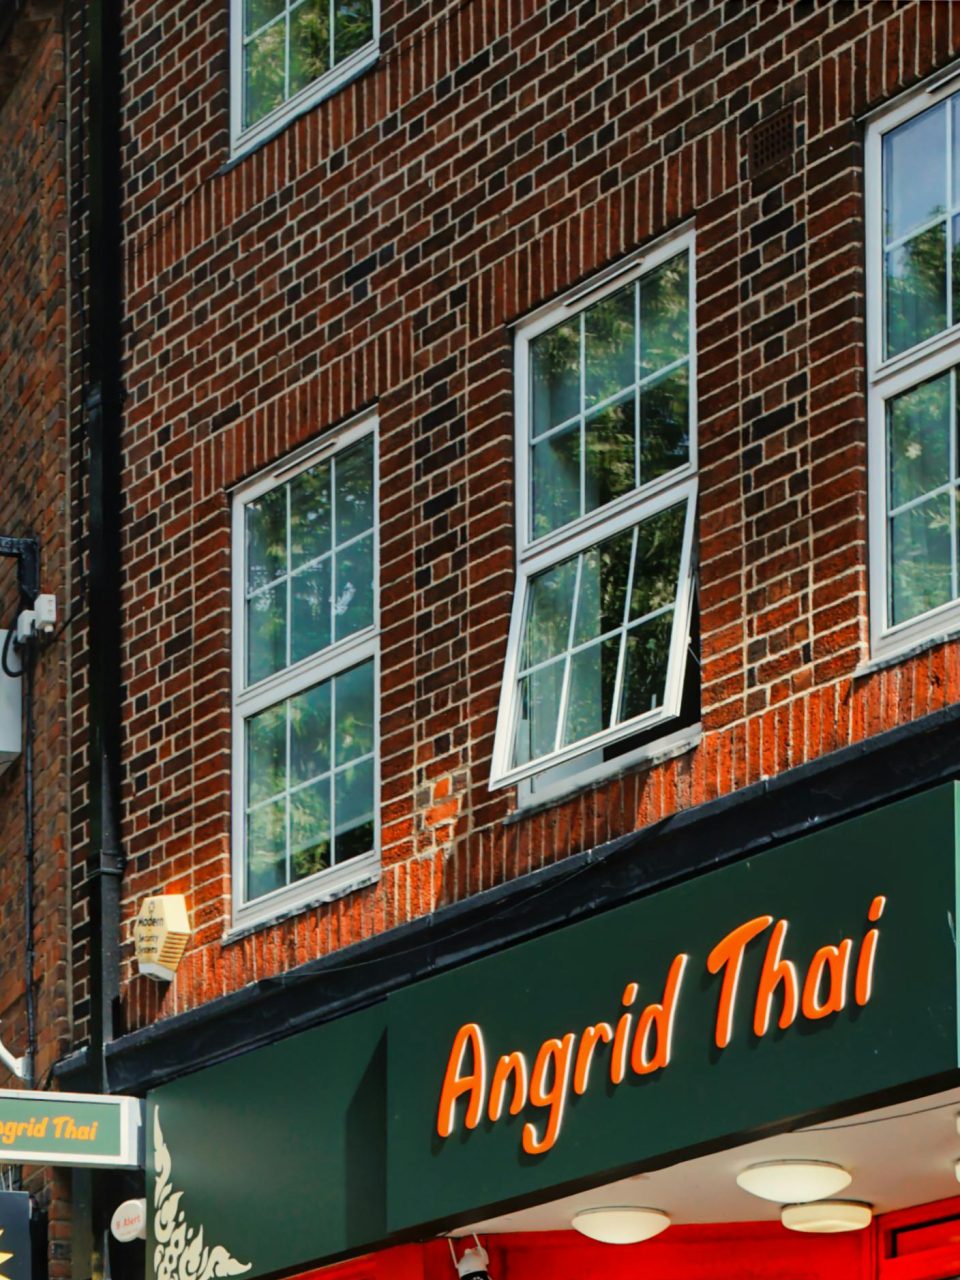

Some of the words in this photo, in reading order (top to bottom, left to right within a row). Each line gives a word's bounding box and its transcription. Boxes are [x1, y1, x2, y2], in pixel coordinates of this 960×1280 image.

[437, 953, 688, 1154] Angrid
[707, 896, 886, 1049] Thai
[51, 1116, 98, 1141] Thai
